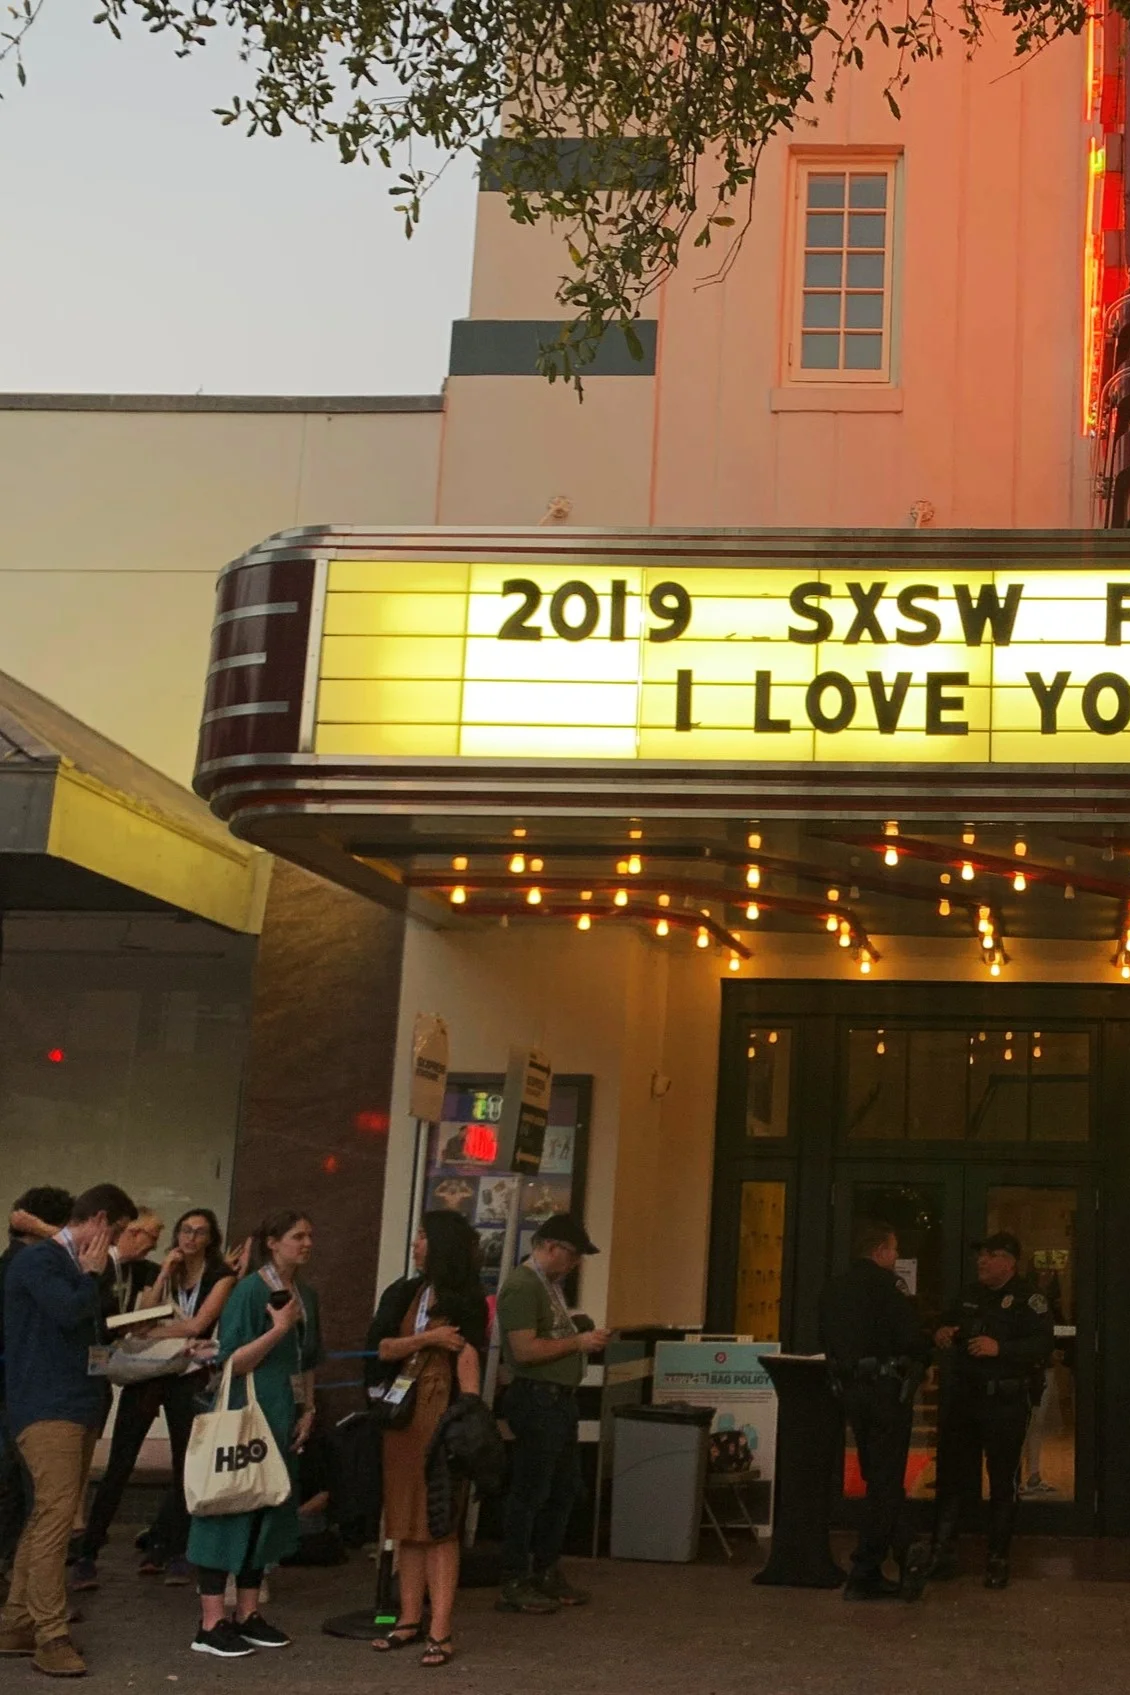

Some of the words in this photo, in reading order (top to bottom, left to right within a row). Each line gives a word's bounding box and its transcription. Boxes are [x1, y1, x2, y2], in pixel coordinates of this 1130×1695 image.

[498, 579, 692, 643] 2019
[788, 581, 1024, 647] SXSW
[674, 669, 693, 732] I
[753, 670, 970, 736] LOVE
[711, 1374, 731, 1385] BAG
[734, 1374, 770, 1385] POLICY
[214, 1438, 268, 1473] HBO
